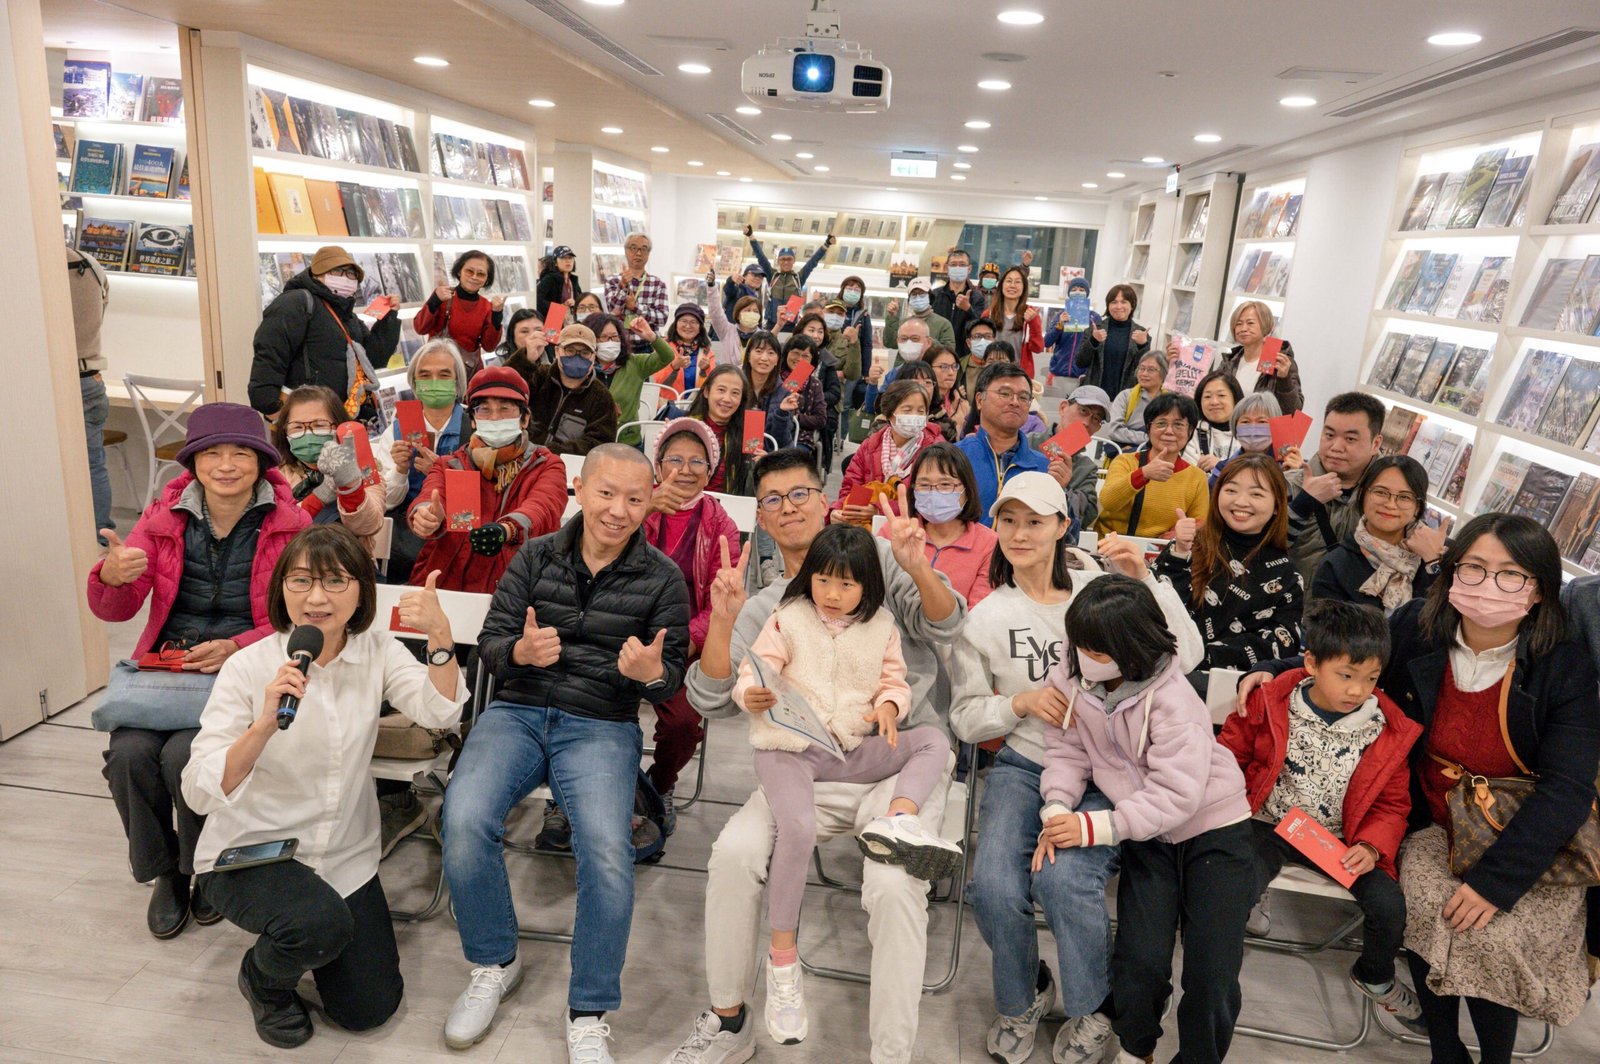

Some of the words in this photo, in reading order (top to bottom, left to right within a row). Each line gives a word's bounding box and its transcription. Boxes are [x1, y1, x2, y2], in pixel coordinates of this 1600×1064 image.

[1265, 557, 1289, 568] SHIRO
[1228, 583, 1251, 601] SHIRO
[1204, 616, 1215, 640] SHIRO
[1244, 645, 1258, 667] SHIR
